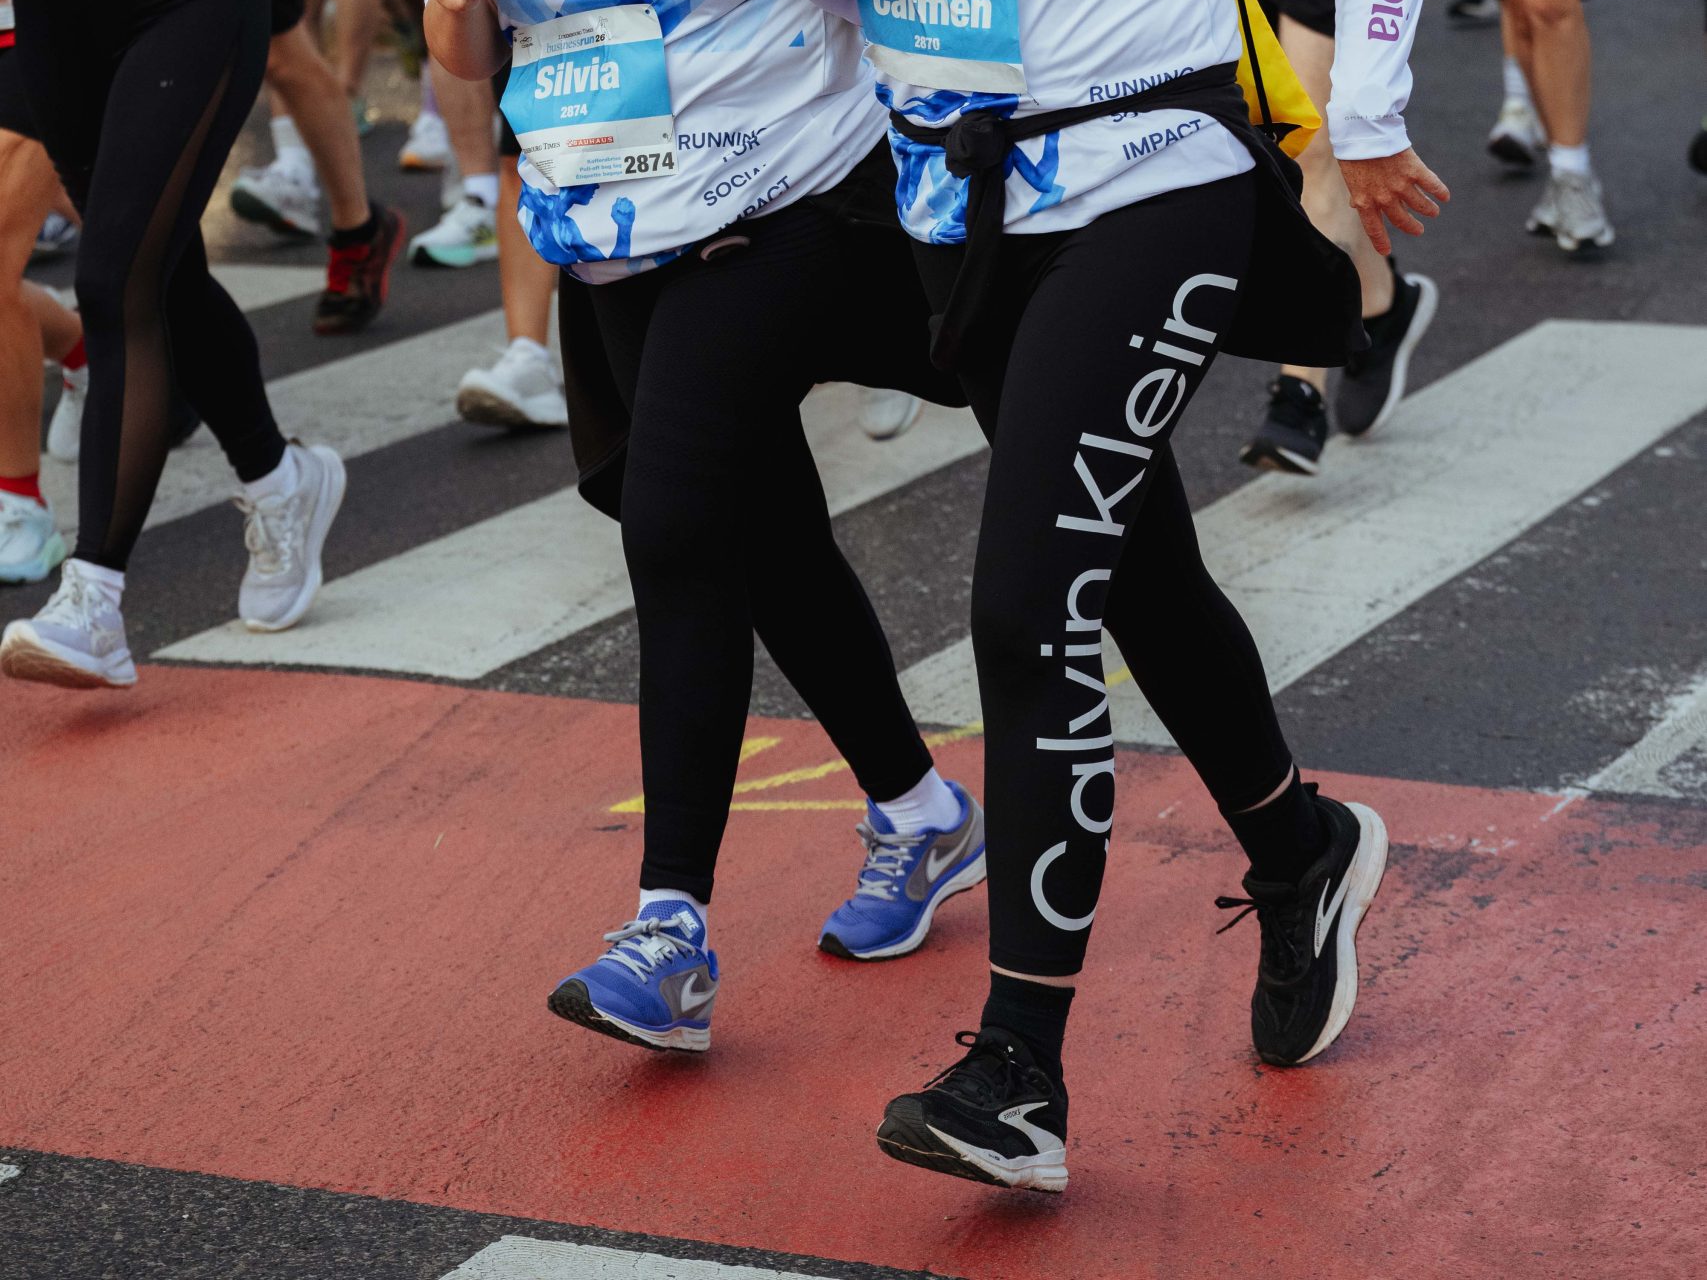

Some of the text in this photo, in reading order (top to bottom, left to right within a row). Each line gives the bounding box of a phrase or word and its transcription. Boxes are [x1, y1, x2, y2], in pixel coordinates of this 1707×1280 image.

[595, 34, 606, 43] 26
[914, 35, 941, 51] 2870
[535, 56, 619, 99] Silvia
[560, 103, 588, 119] 2874
[573, 136, 613, 146] BAUHAUS
[1122, 118, 1201, 161] IMPACT
[624, 152, 675, 175] 2874
[1030, 273, 1238, 932] Calvin Klein
[677, 910, 699, 931] NIKE
